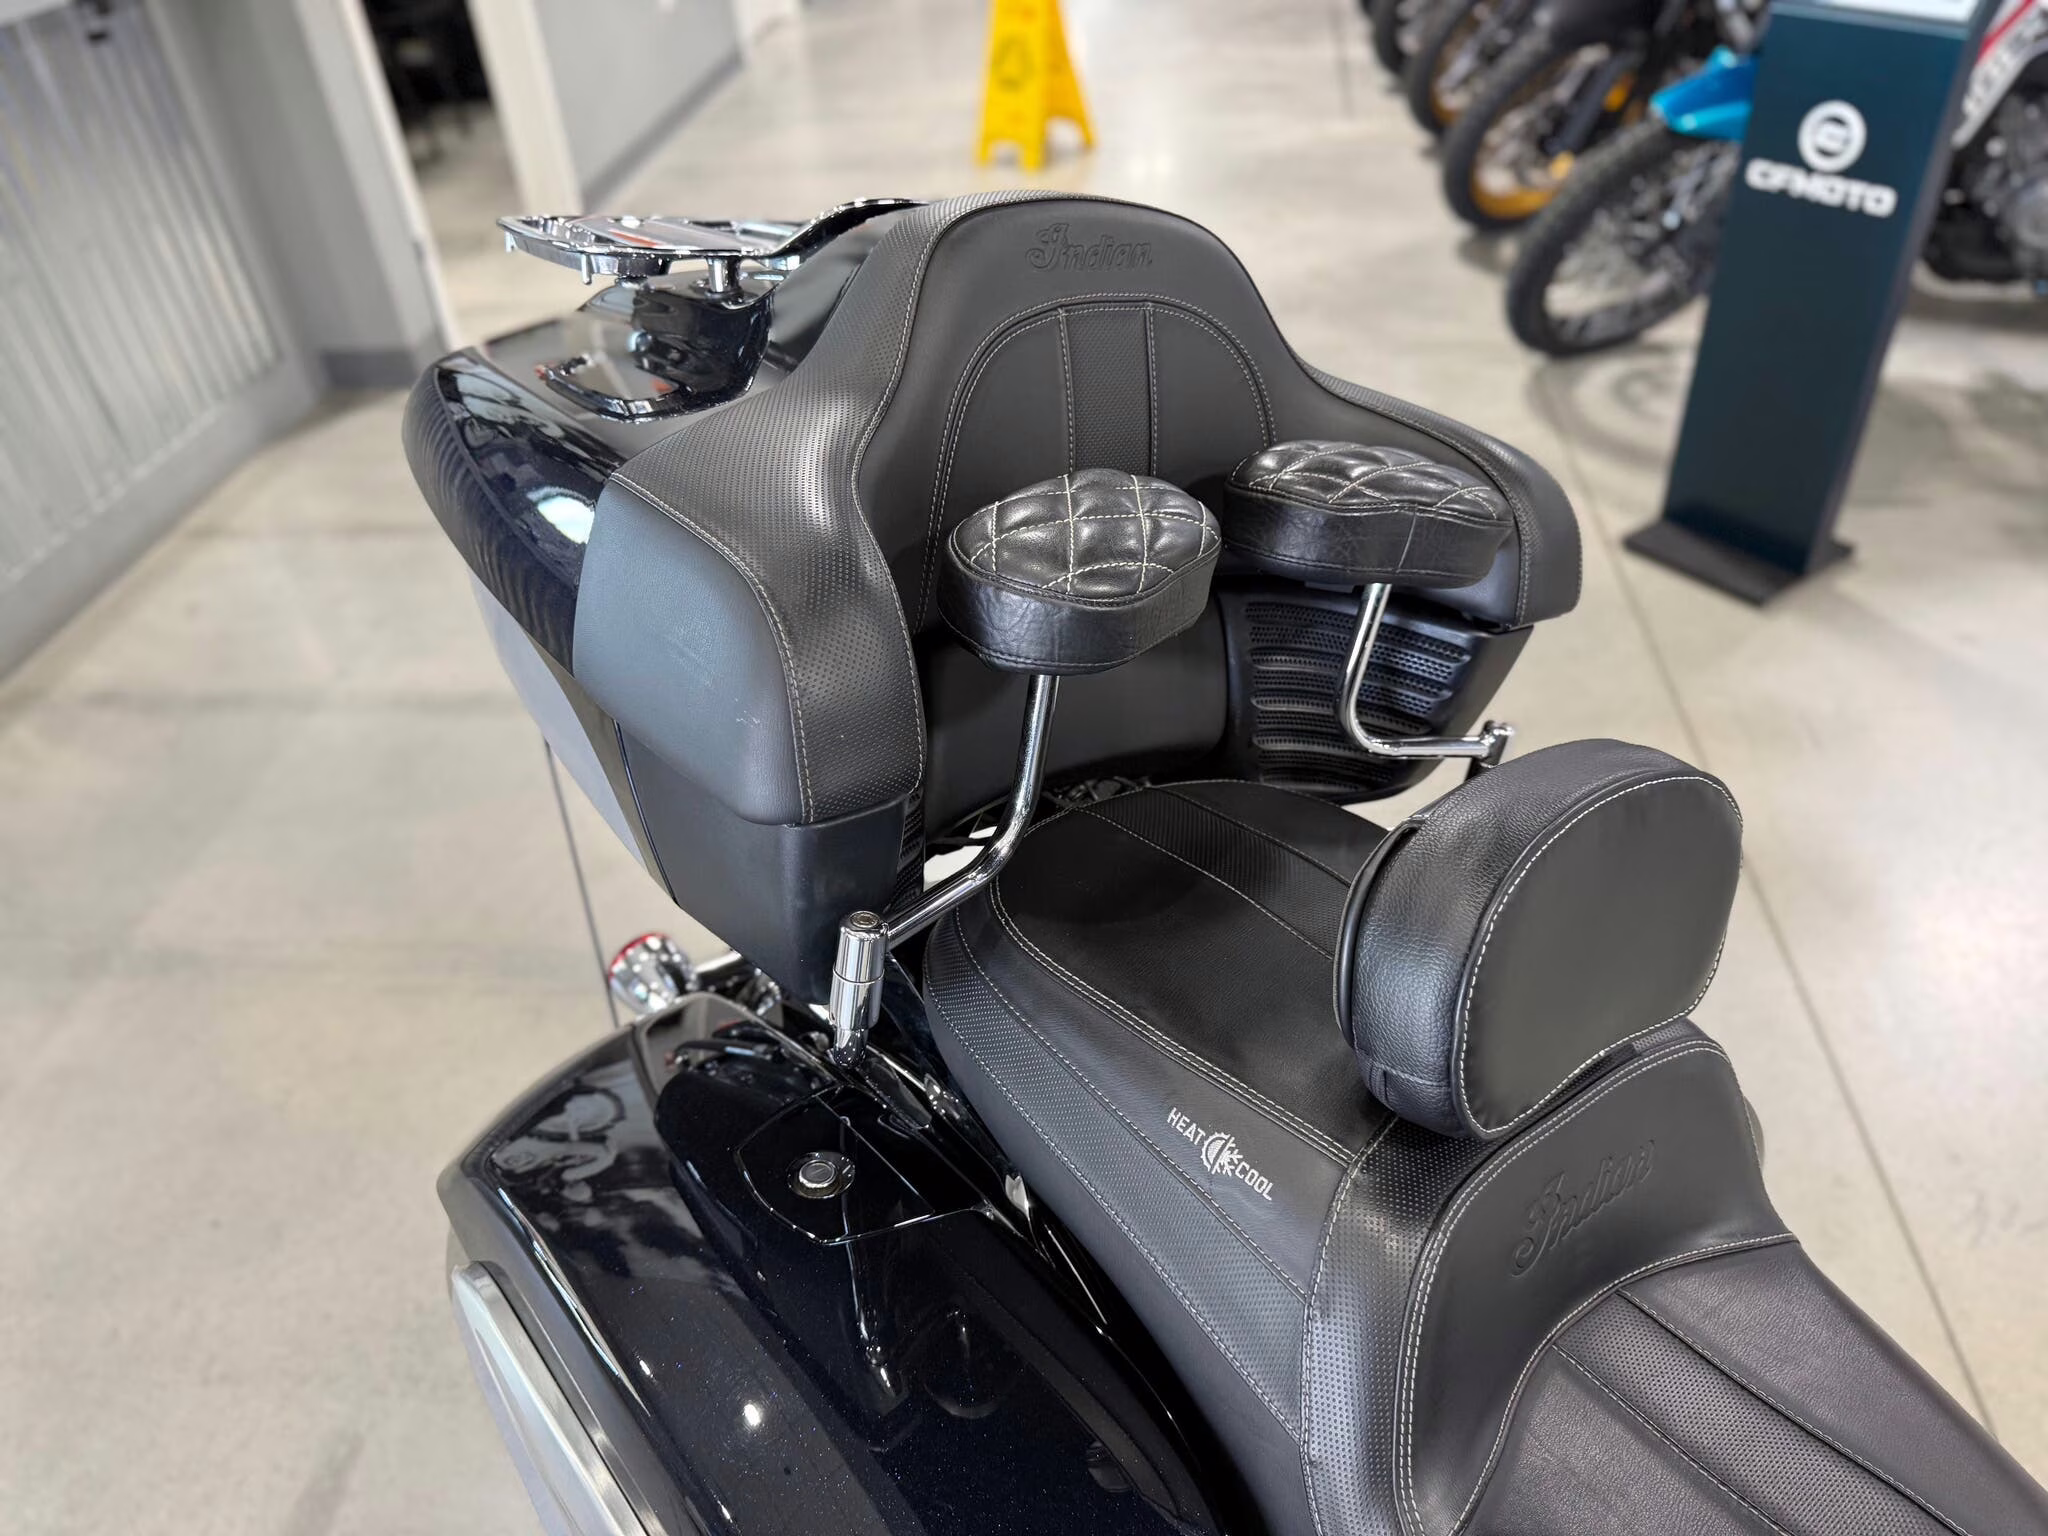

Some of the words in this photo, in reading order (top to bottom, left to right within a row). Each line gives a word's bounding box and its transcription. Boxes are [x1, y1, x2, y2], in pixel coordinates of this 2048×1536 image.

[1745, 157, 1898, 218] CFMOTO
[1025, 223, 1154, 272] Indian
[1166, 1107, 1206, 1145] HEAT
[1234, 1161, 1273, 1201] COOL
[1510, 1139, 1654, 1277] Indian
